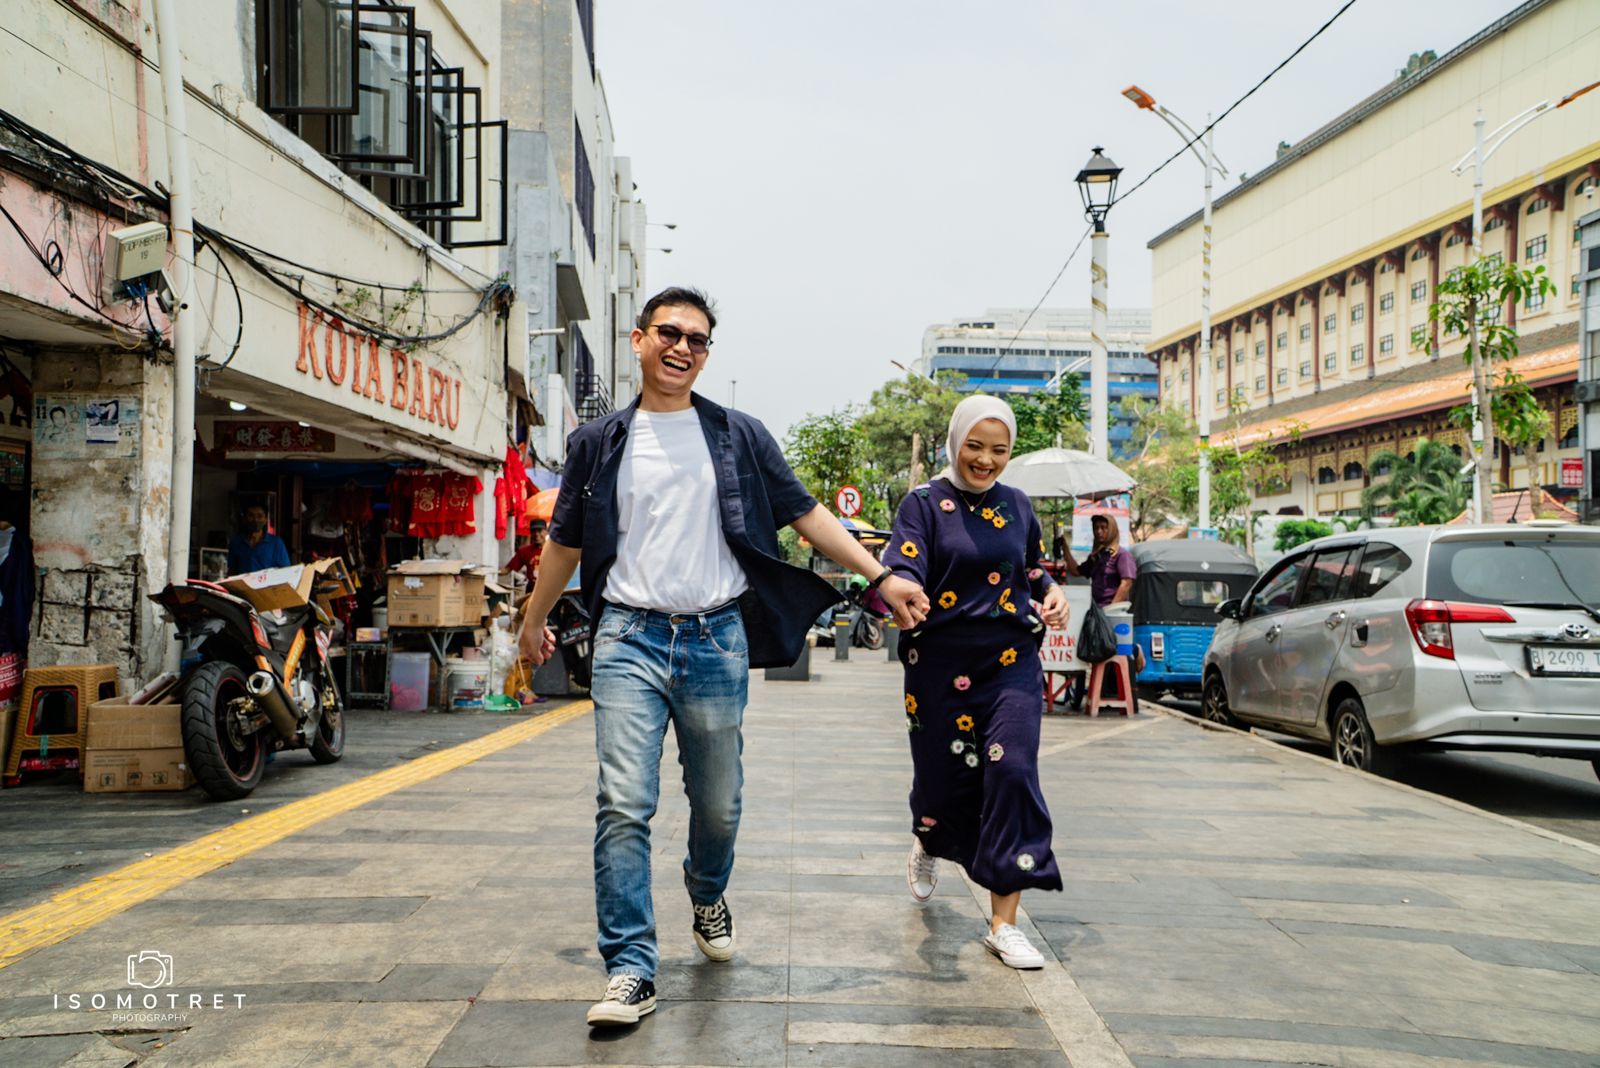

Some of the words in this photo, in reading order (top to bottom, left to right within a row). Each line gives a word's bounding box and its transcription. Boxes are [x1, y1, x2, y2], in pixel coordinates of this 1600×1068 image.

[296, 302, 385, 404] KOTA
[391, 349, 462, 431] BARU
[845, 492, 856, 510] P
[1531, 650, 1541, 665] B
[1547, 650, 1585, 666] 2499
